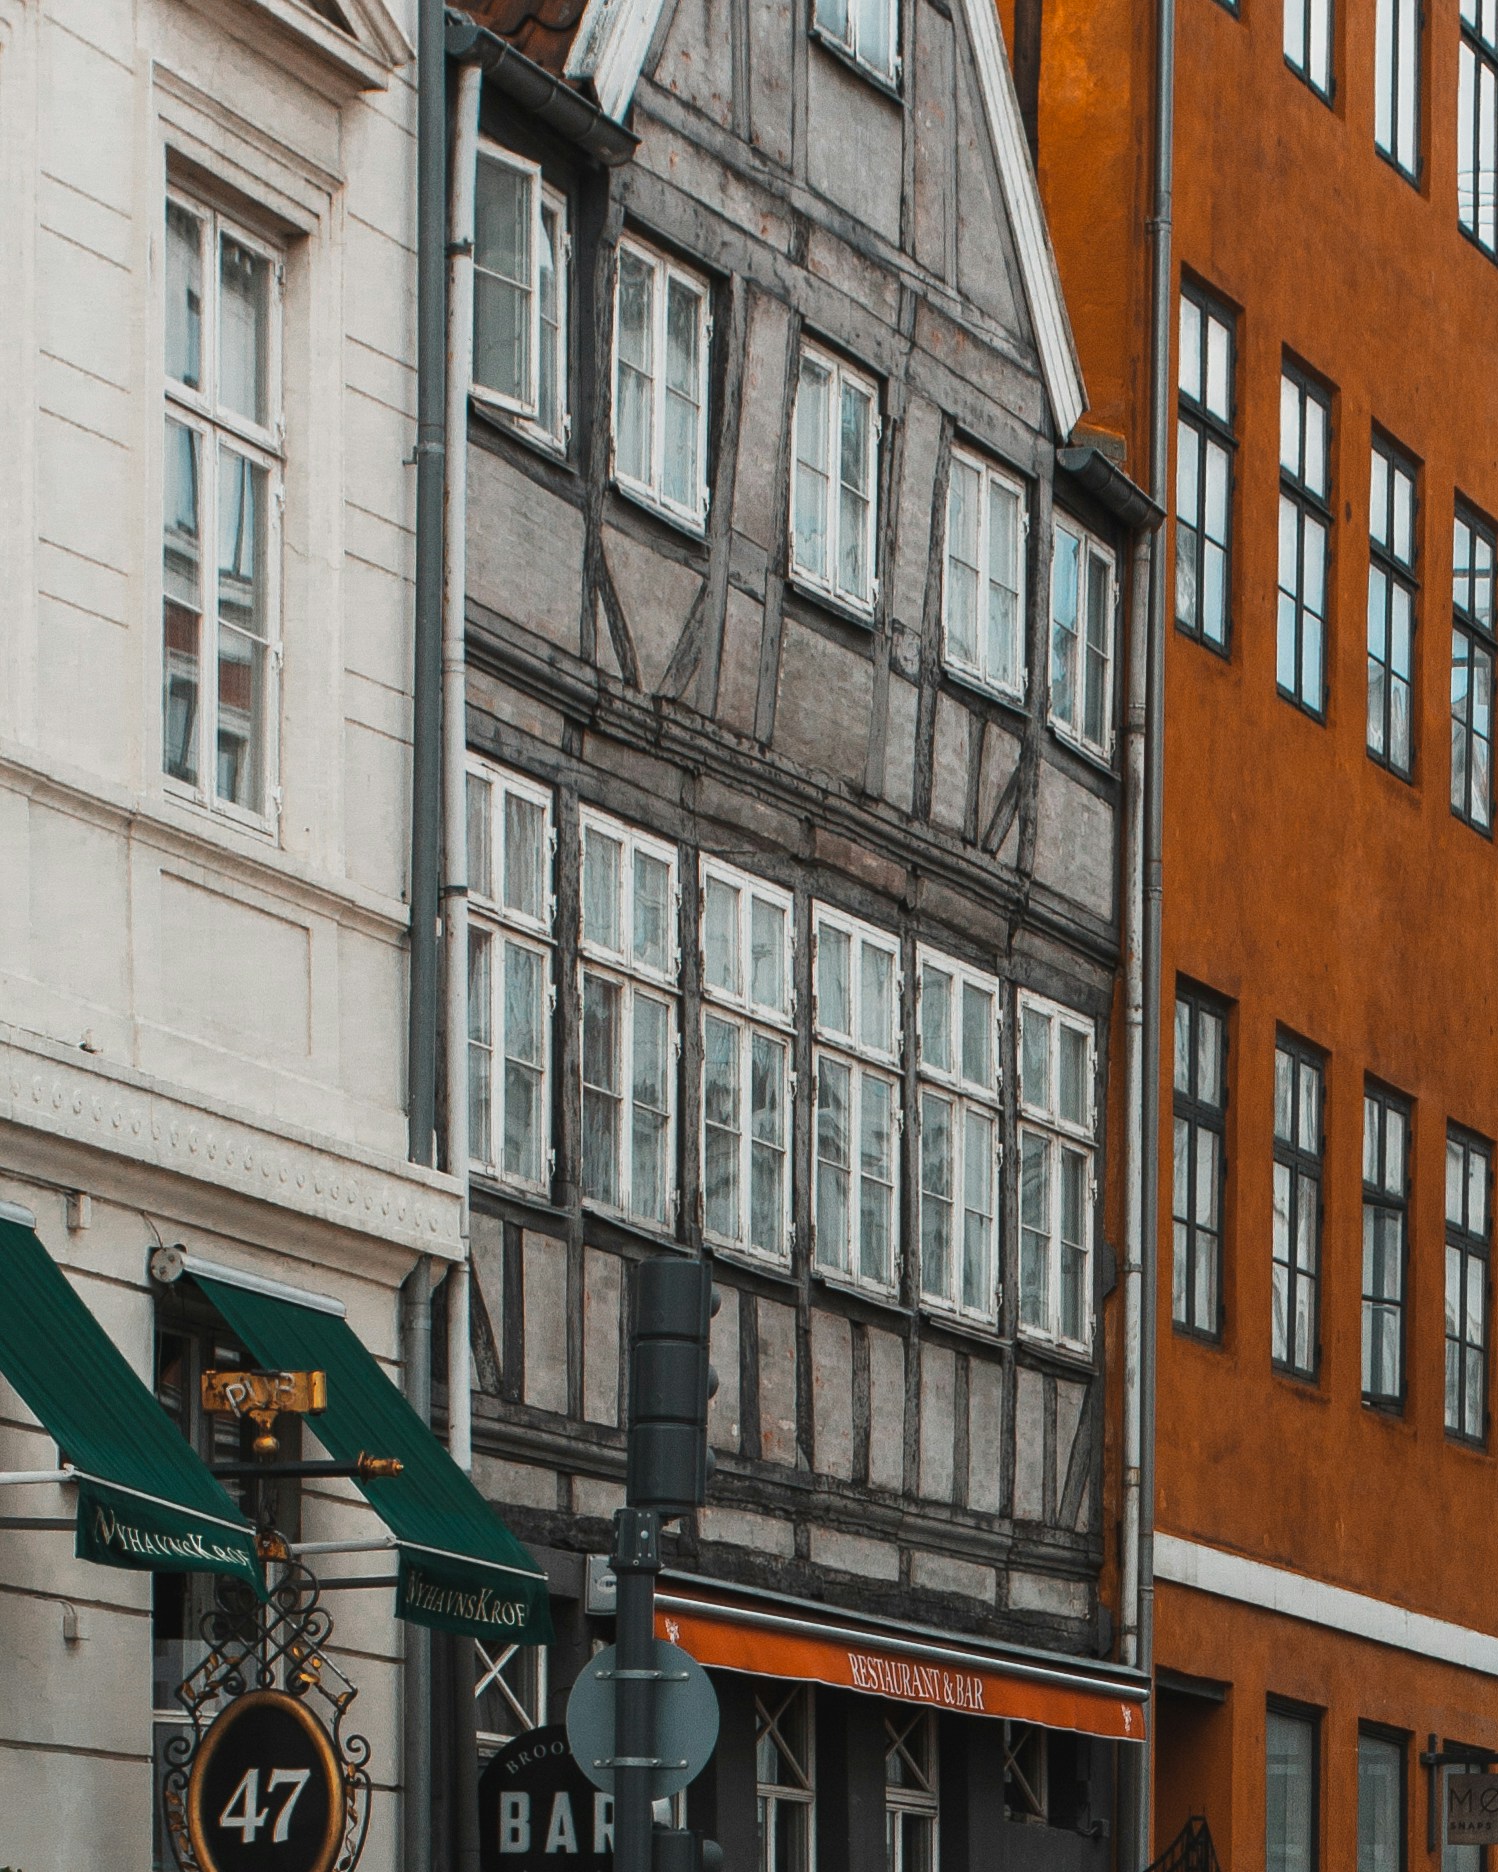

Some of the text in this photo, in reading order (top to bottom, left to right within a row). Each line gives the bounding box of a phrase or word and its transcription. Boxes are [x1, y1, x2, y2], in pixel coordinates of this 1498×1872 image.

[848, 1653, 985, 1710] RESTAURANT & BAR
[505, 1741, 573, 1775] BROO
[219, 1768, 312, 1843] 47
[500, 1791, 615, 1854] BAR
